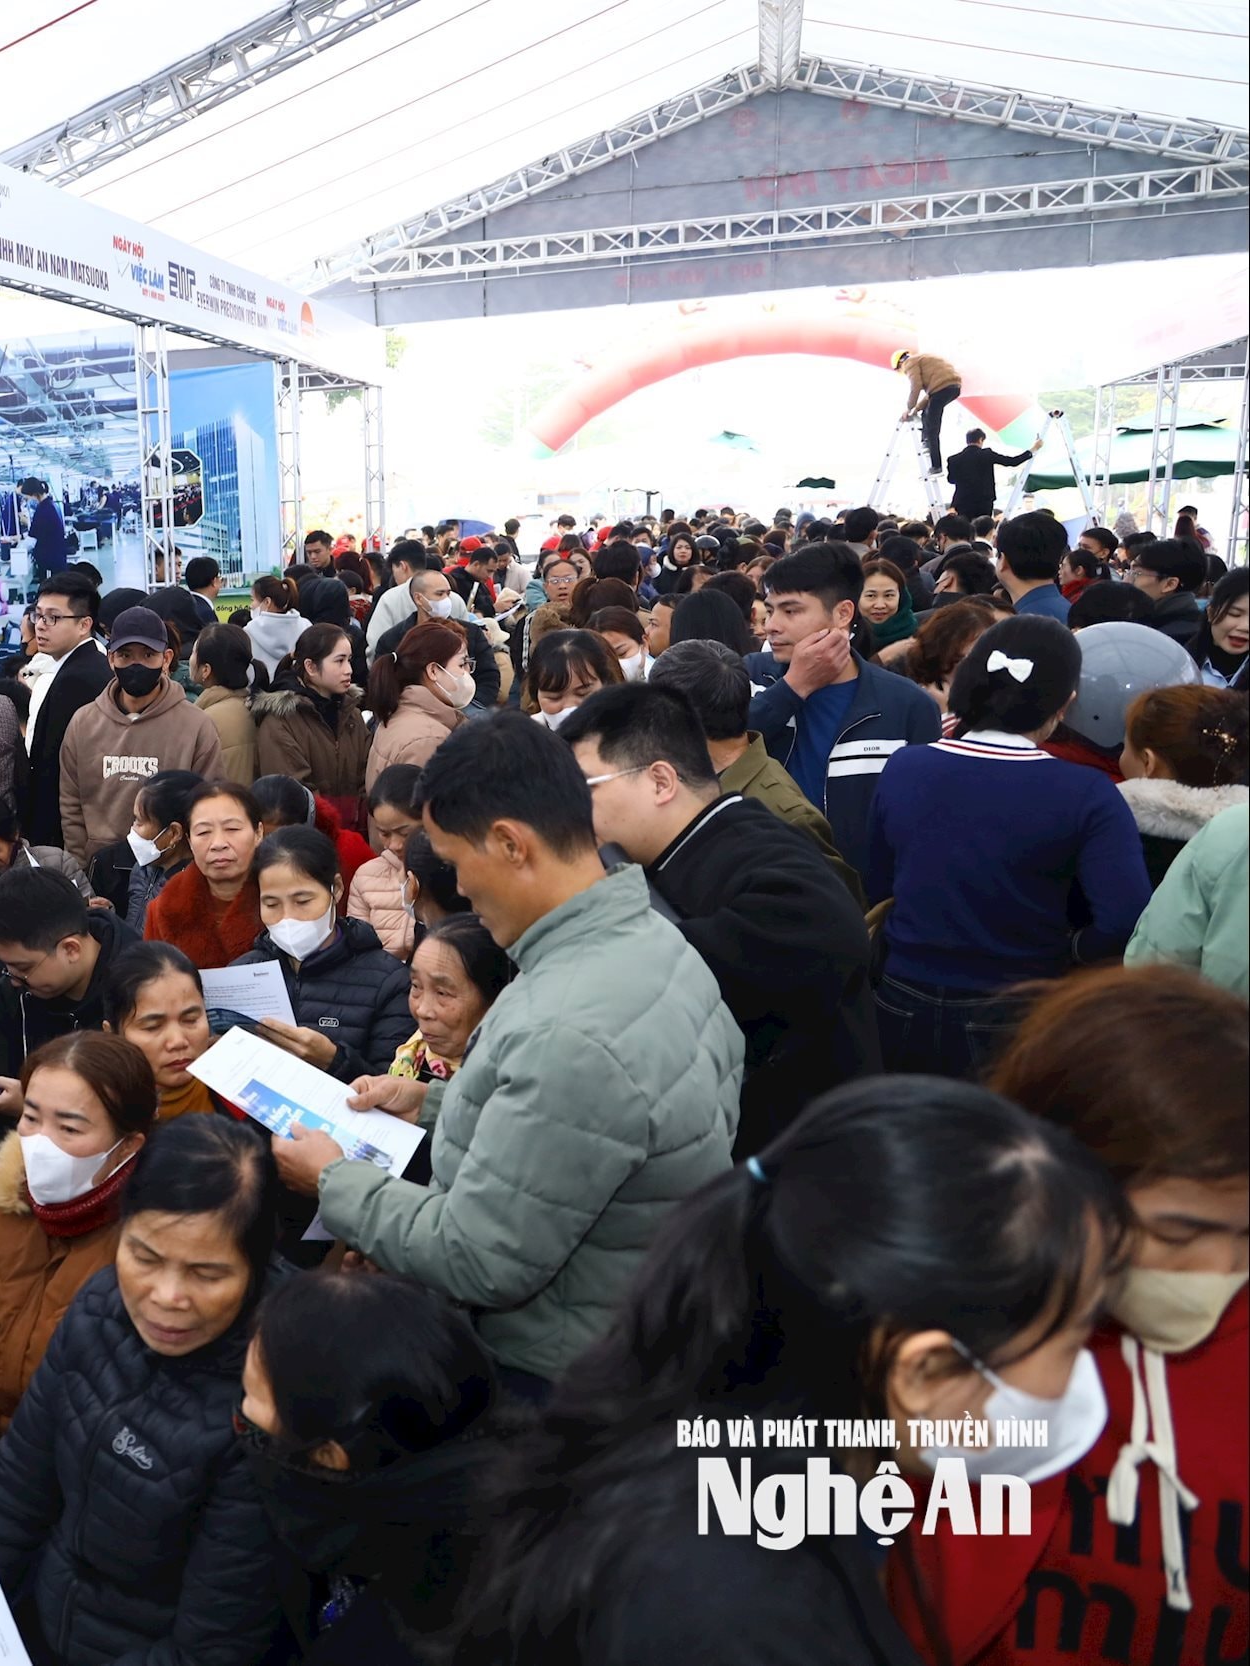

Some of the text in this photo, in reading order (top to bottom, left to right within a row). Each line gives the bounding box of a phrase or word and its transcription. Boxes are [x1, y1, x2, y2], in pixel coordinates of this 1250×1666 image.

[16, 243, 34, 269] MAY
[37, 250, 49, 273] AN
[50, 253, 69, 279] NAM
[70, 260, 109, 291] MATSUOKA
[103, 756, 159, 779] CROOKS
